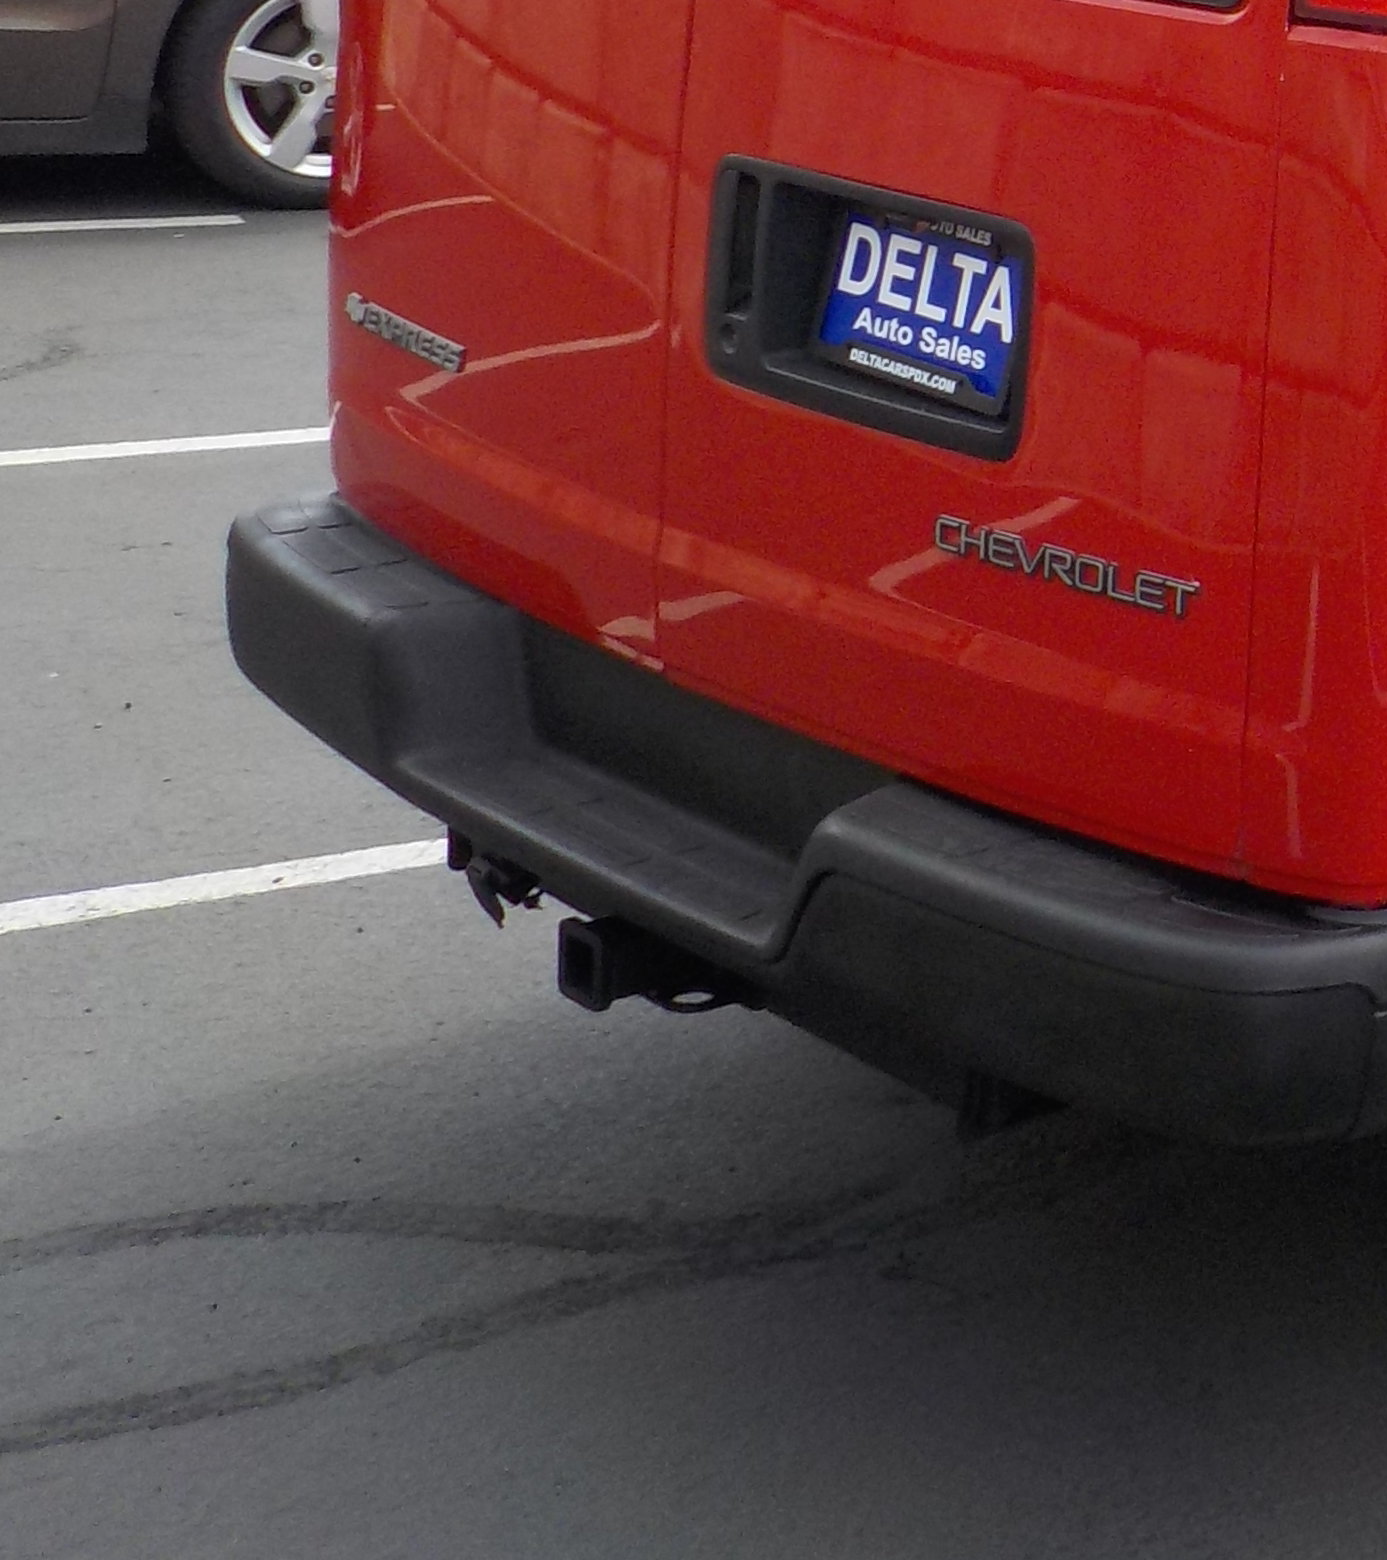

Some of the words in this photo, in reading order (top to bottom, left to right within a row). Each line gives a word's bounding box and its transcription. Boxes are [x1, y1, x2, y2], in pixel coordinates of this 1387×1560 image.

[836, 221, 1014, 344] DELTA
[852, 306, 914, 346] Auto
[919, 325, 988, 371] Sales
[934, 513, 1201, 616] CHEVROLET
